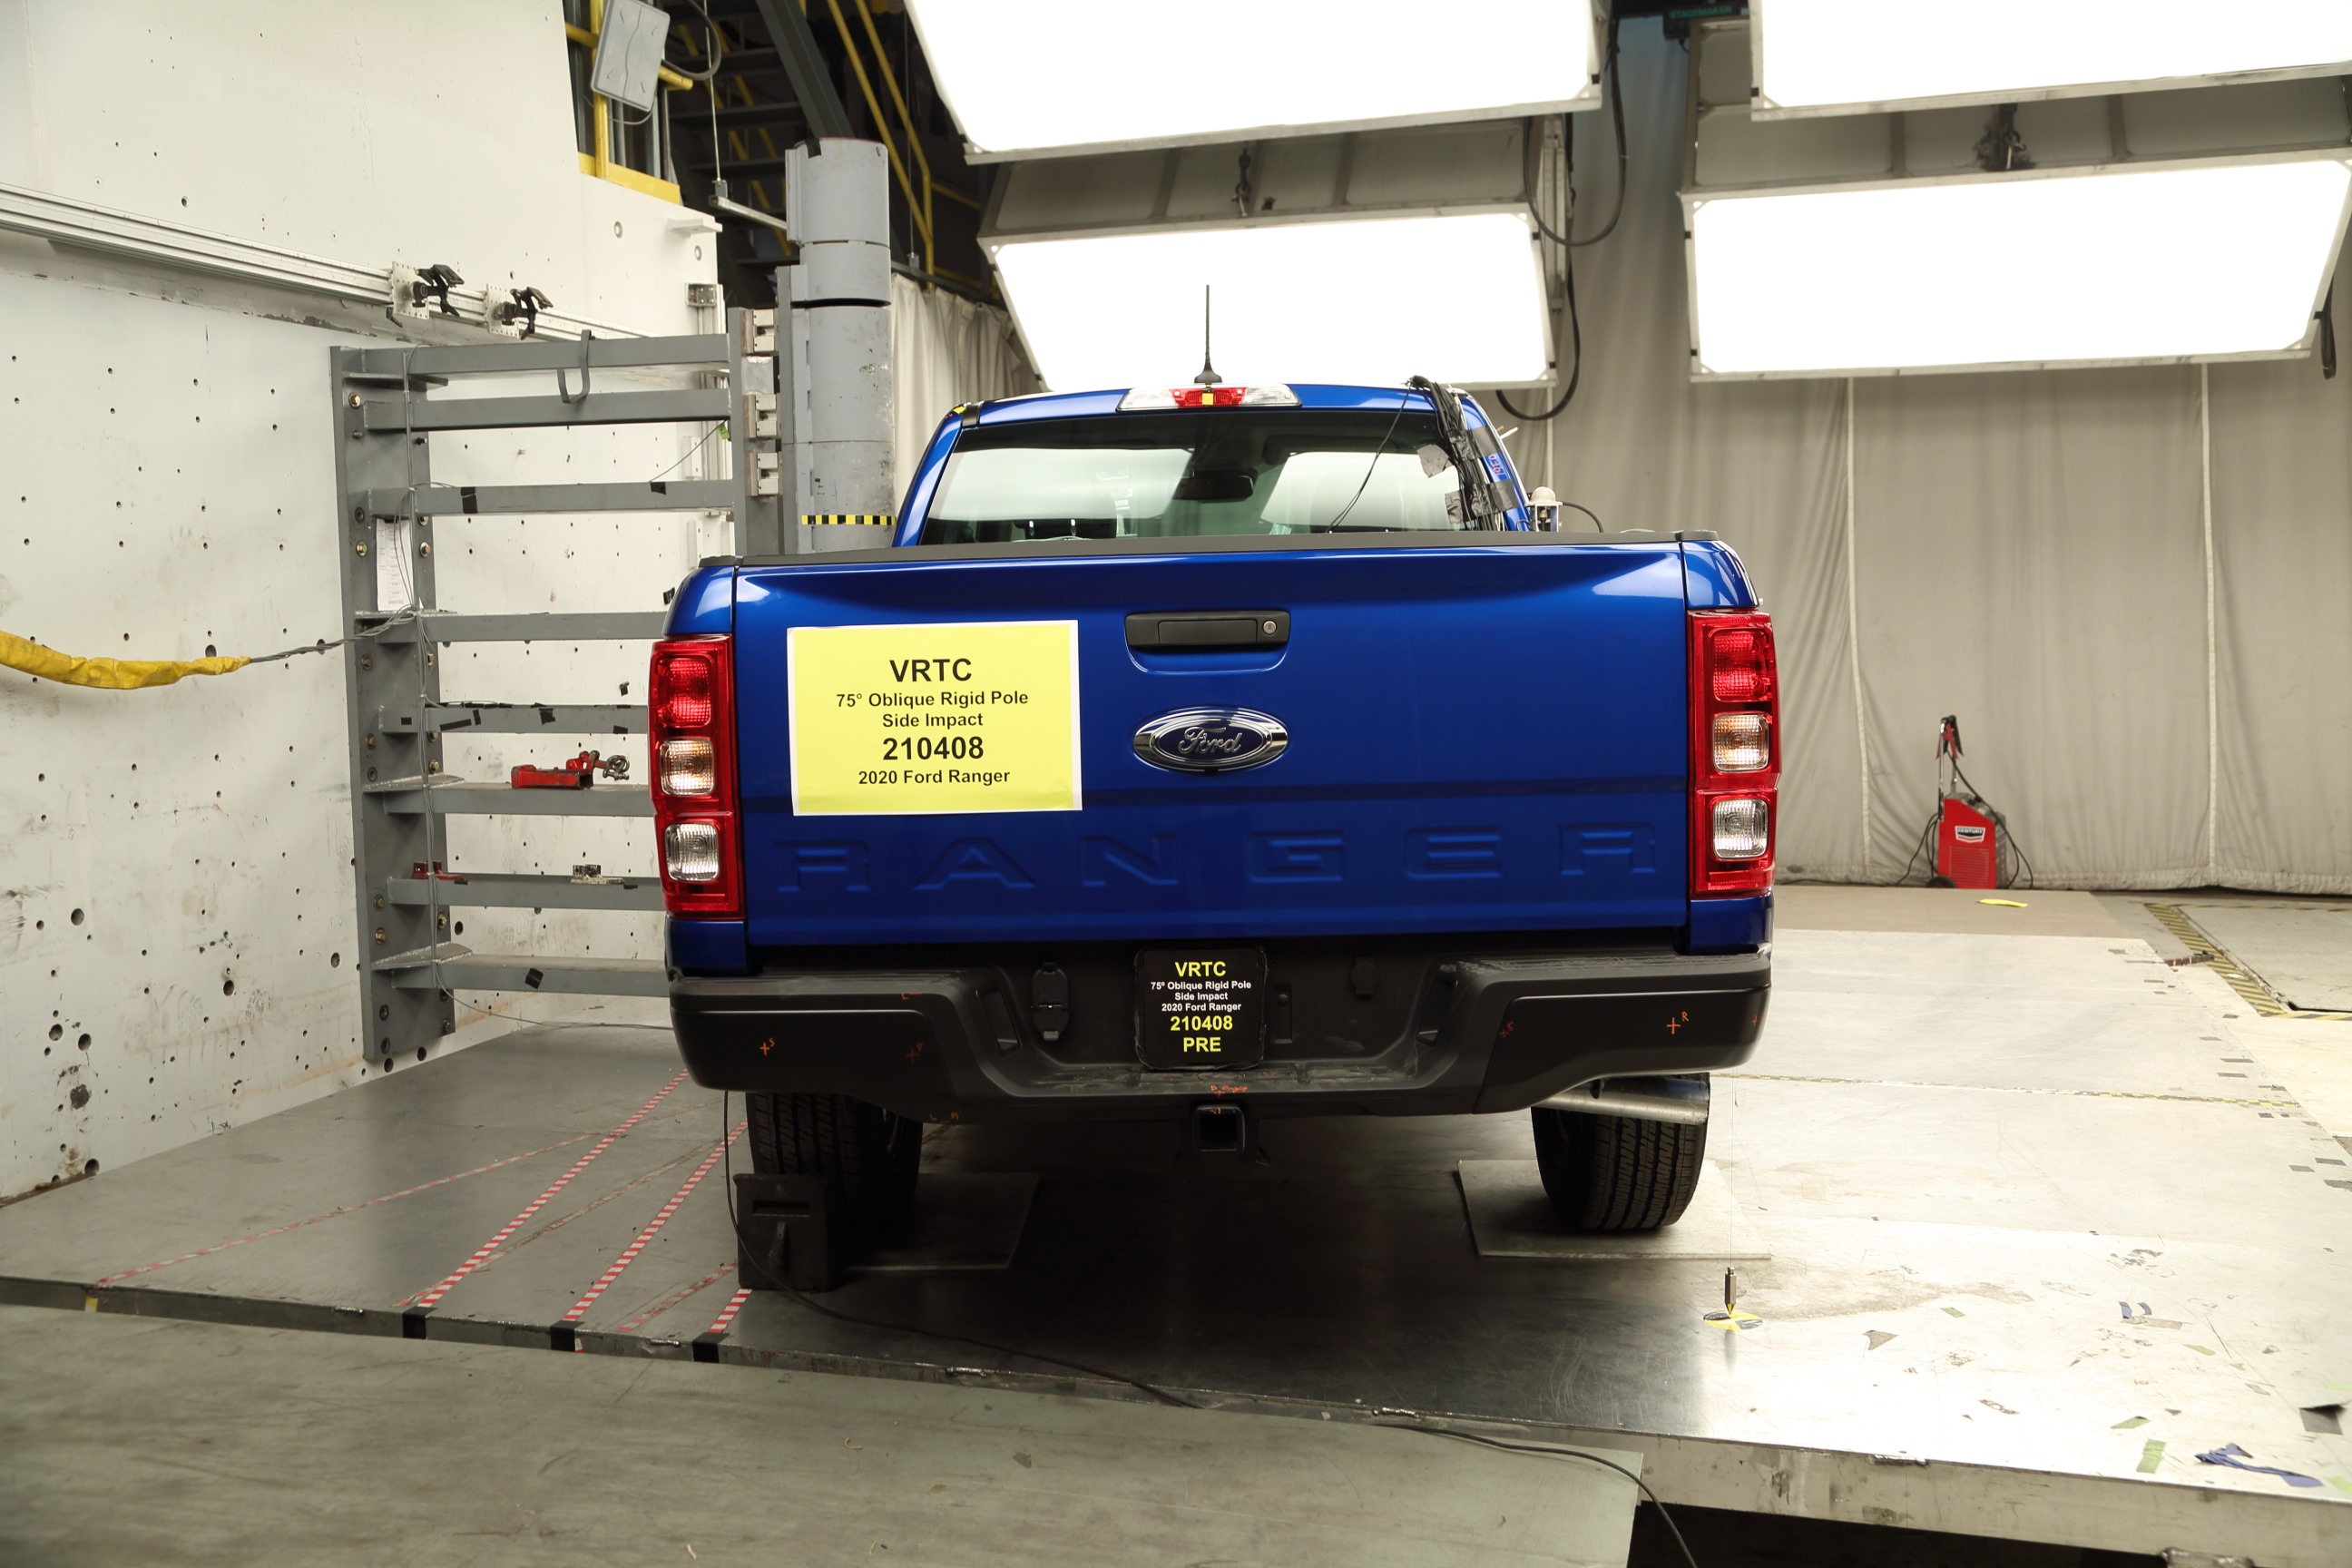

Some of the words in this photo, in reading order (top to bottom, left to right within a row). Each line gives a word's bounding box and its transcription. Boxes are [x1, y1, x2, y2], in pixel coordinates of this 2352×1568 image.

[889, 658, 973, 682] VRTC
[868, 691, 935, 710] Oblique
[940, 691, 986, 709] Rigid
[991, 690, 1029, 705] Pole
[882, 713, 920, 728] Side
[926, 712, 984, 730] Impact
[883, 736, 985, 760] 210408
[1179, 726, 1243, 755] Ford
[858, 770, 897, 785] 2020
[904, 769, 943, 784] Ford
[948, 769, 1010, 786] Ranger
[776, 822, 1657, 893] RANGER
[1174, 961, 1227, 977] VRTC
[1167, 981, 1203, 992] Oblique
[1205, 981, 1230, 992] Rigid
[1231, 980, 1252, 989] Pole
[1174, 992, 1195, 1001] Side
[1197, 992, 1229, 1002] Impact
[1161, 1003, 1183, 1012] 2020
[1185, 1002, 1207, 1012] Ford
[1209, 1003, 1242, 1013] Ranger
[1170, 1015, 1233, 1031] 210408
[1183, 1037, 1221, 1053] PRE
